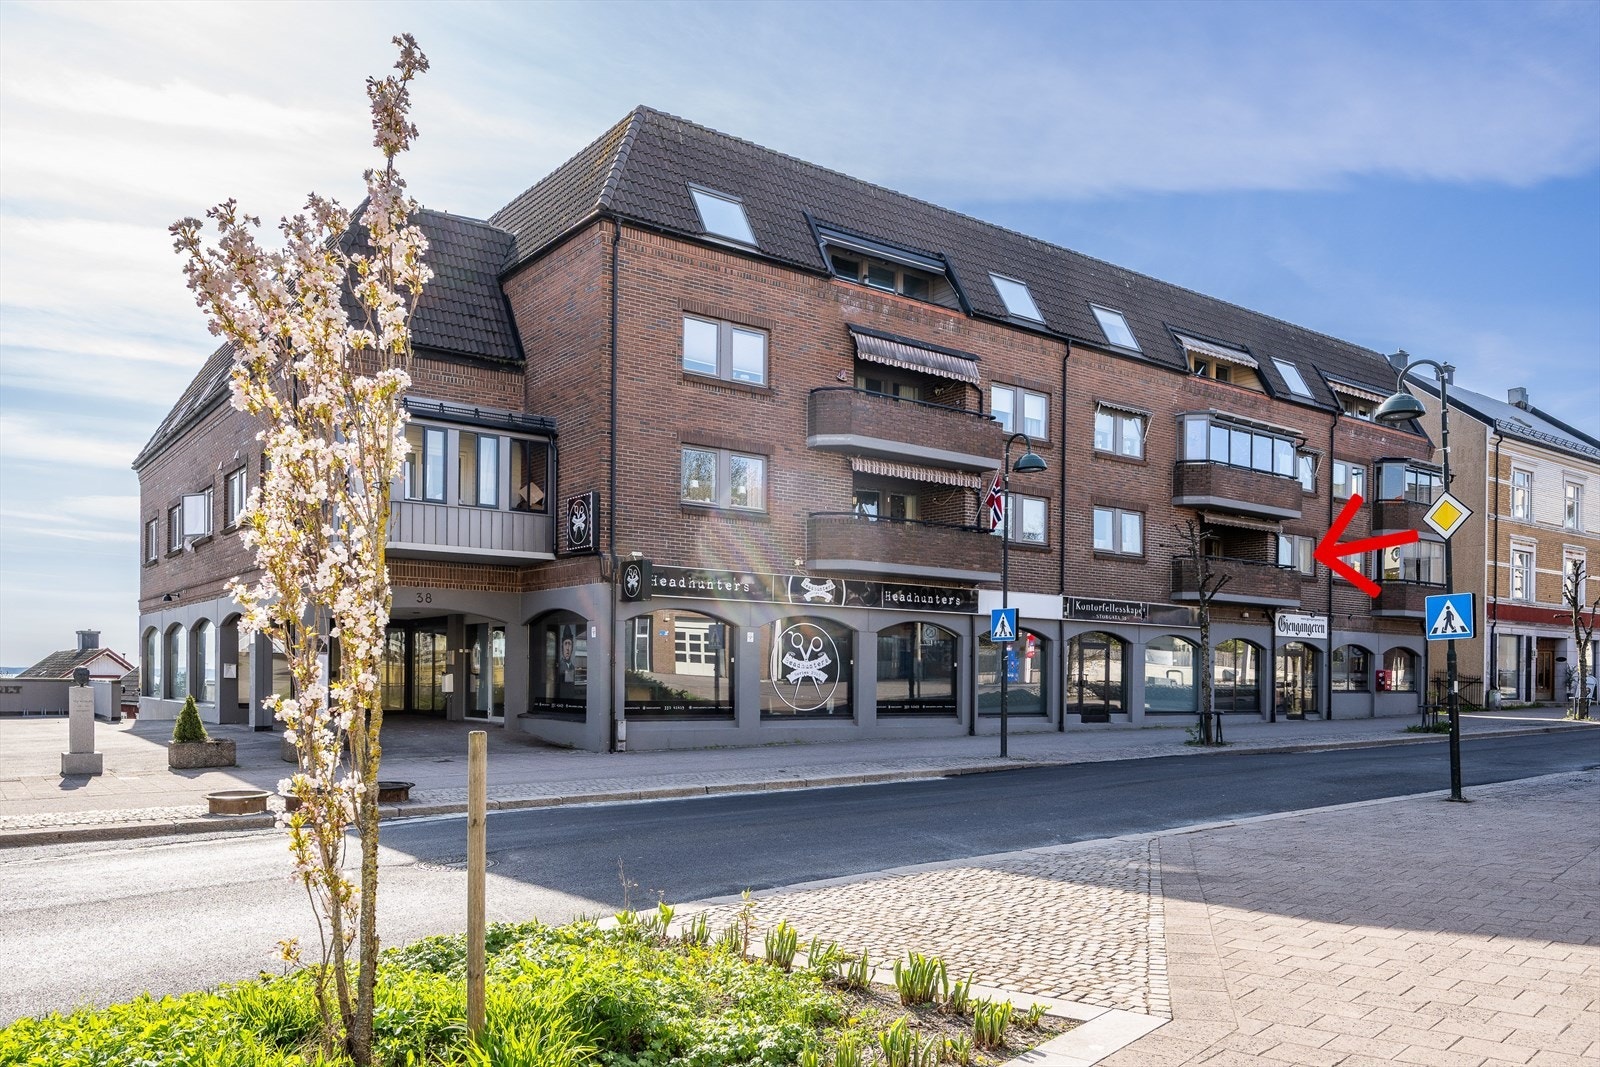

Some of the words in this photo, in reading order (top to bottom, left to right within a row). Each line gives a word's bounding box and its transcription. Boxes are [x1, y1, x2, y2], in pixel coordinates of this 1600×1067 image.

[651, 574, 750, 592] Headhunters
[416, 592, 432, 604] 38
[885, 590, 961, 606] Headhunters
[1278, 615, 1325, 637] Gjengangeren
